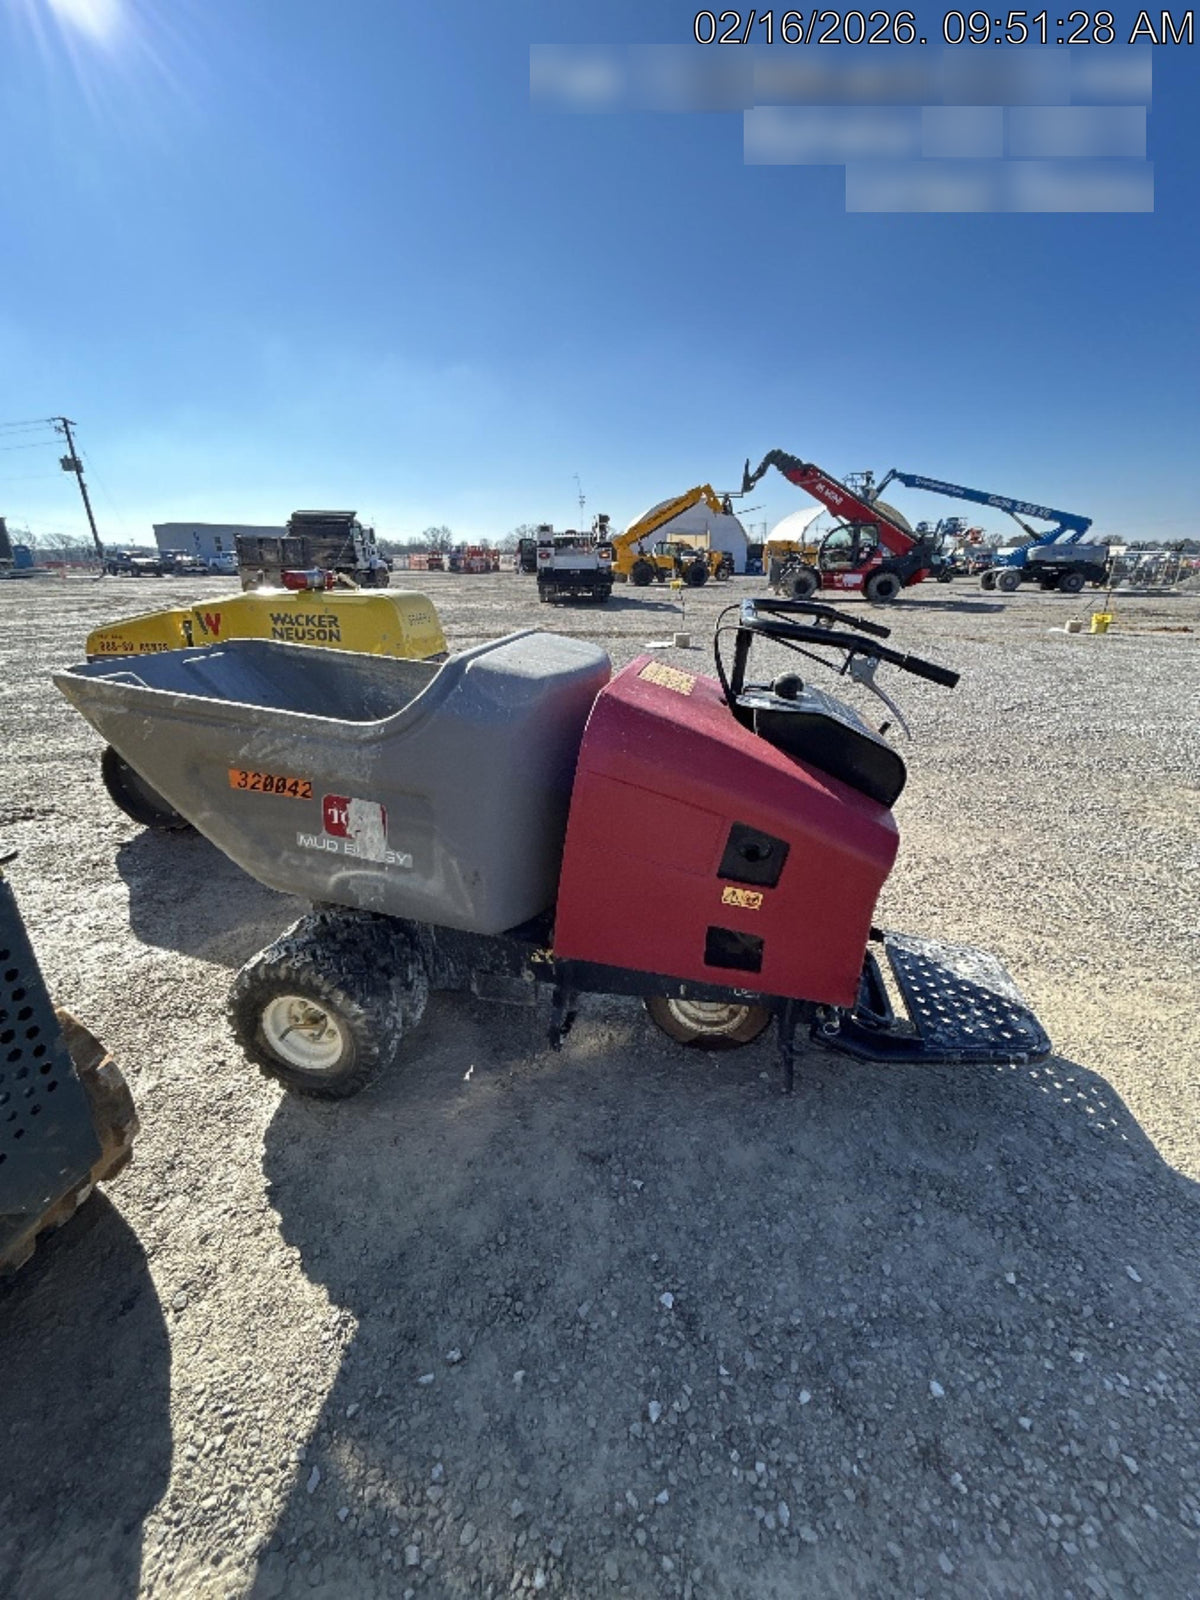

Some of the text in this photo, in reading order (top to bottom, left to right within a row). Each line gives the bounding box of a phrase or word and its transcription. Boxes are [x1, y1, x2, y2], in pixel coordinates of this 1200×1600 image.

[269, 612, 339, 629] WACKER
[271, 627, 342, 643] NEUSON
[237, 771, 313, 799] 320042
[298, 835, 338, 852] MUD
